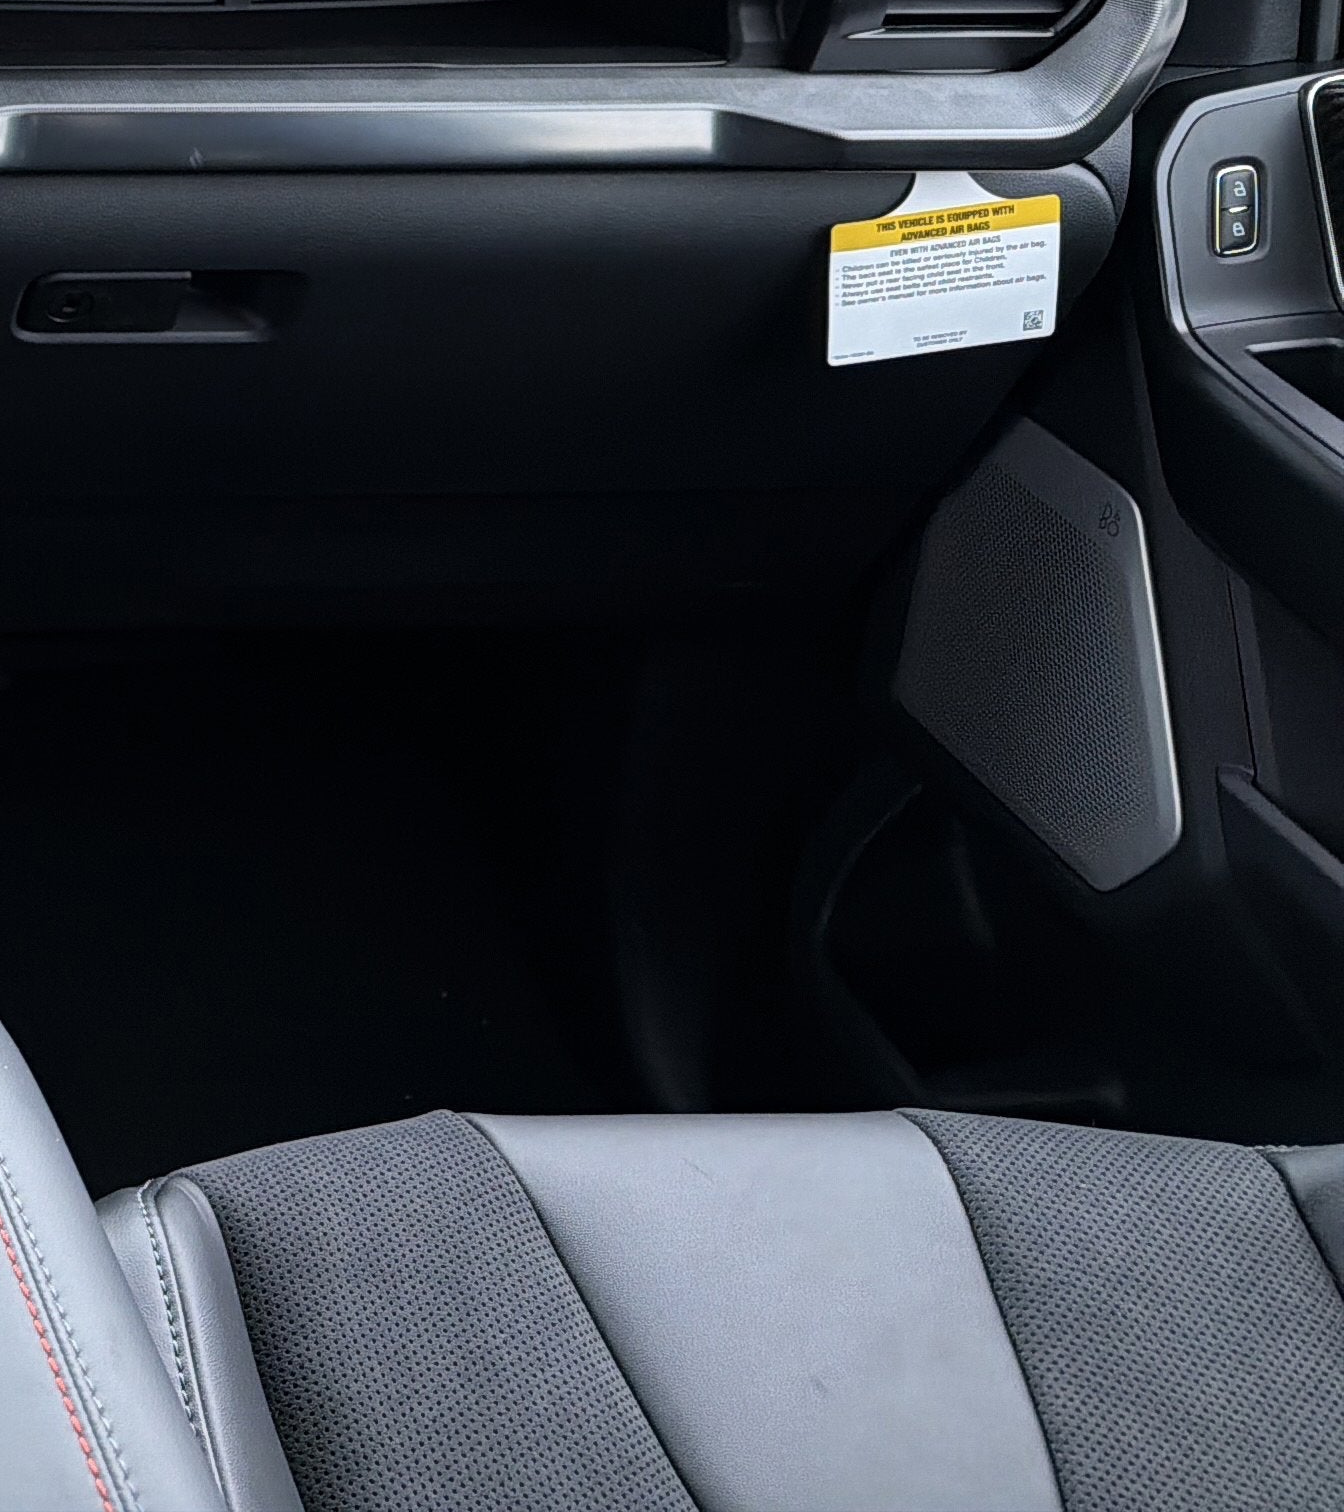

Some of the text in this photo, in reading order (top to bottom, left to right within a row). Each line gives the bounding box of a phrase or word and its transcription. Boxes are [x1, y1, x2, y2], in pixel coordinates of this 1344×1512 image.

[876, 205, 1015, 232] THIS VEHICLE IS EQUIPPED WITH
[901, 221, 990, 242] ADVANCED AIR BAGS
[930, 240, 966, 251] ADVANCED
[968, 238, 980, 246] AIR
[982, 235, 1001, 244] BAGS
